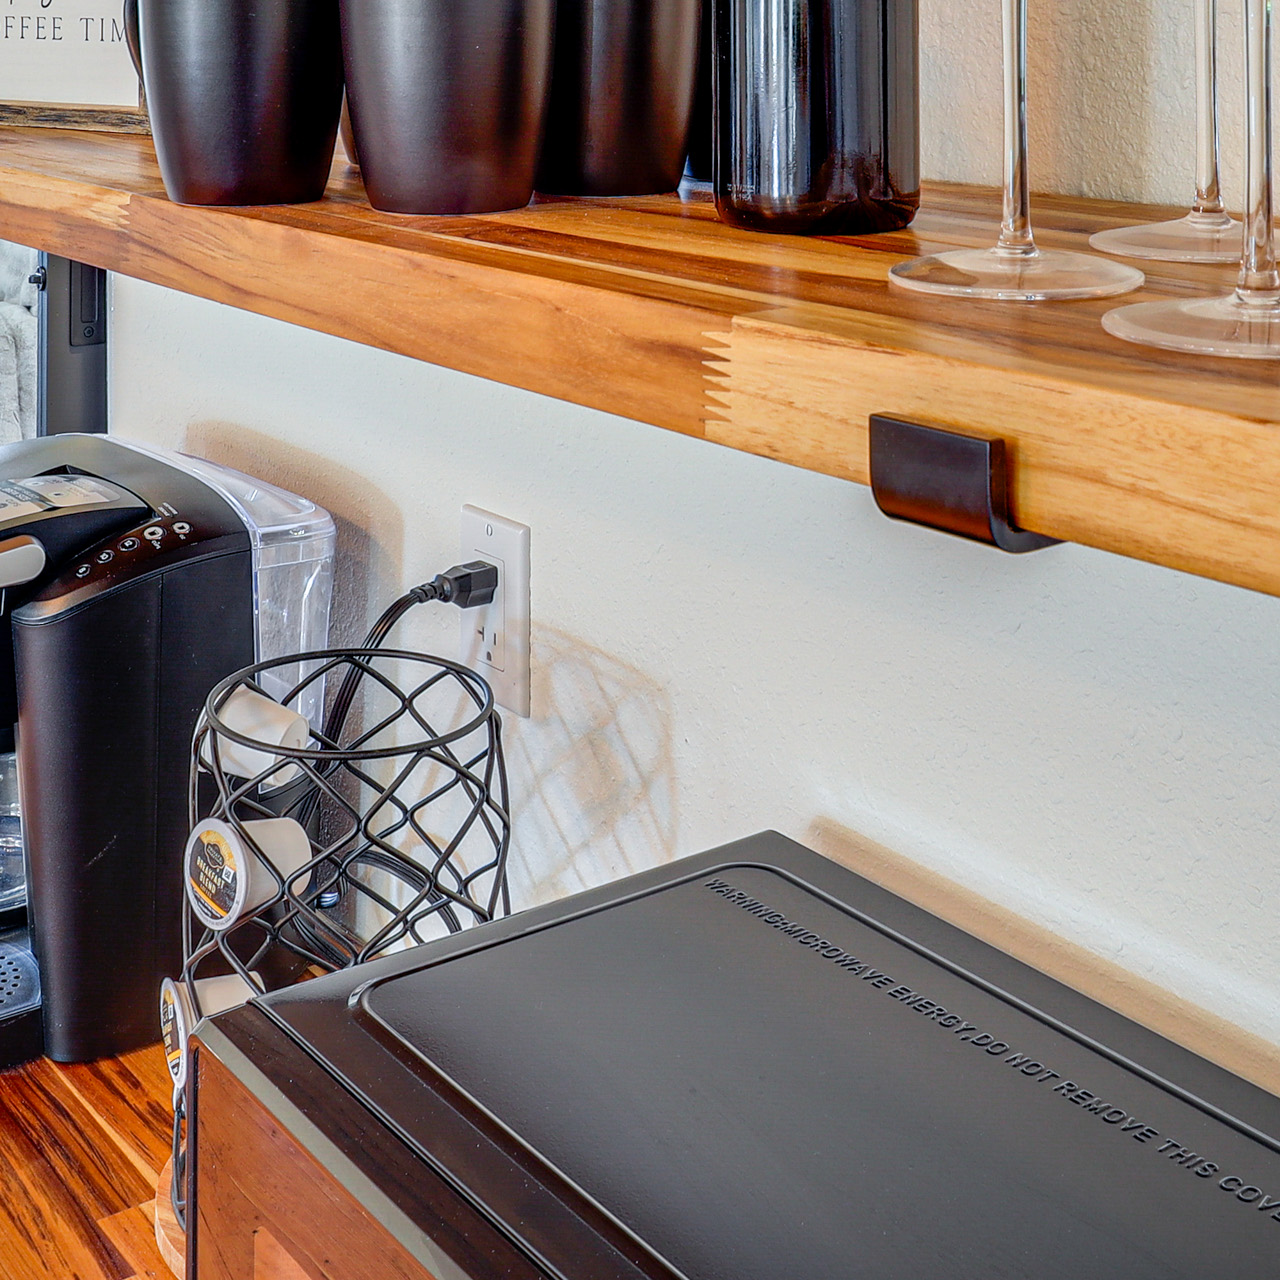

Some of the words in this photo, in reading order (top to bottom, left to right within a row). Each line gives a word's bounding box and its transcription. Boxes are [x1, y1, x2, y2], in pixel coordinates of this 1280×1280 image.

[79, 17, 127, 43] TIM
[196, 855, 225, 889] BREAKFAST
[199, 872, 217, 895] BLEND
[1004, 1052, 1061, 1083] NOT
[1053, 1080, 1160, 1143] REMOVE
[1157, 1137, 1220, 1178] THIS
